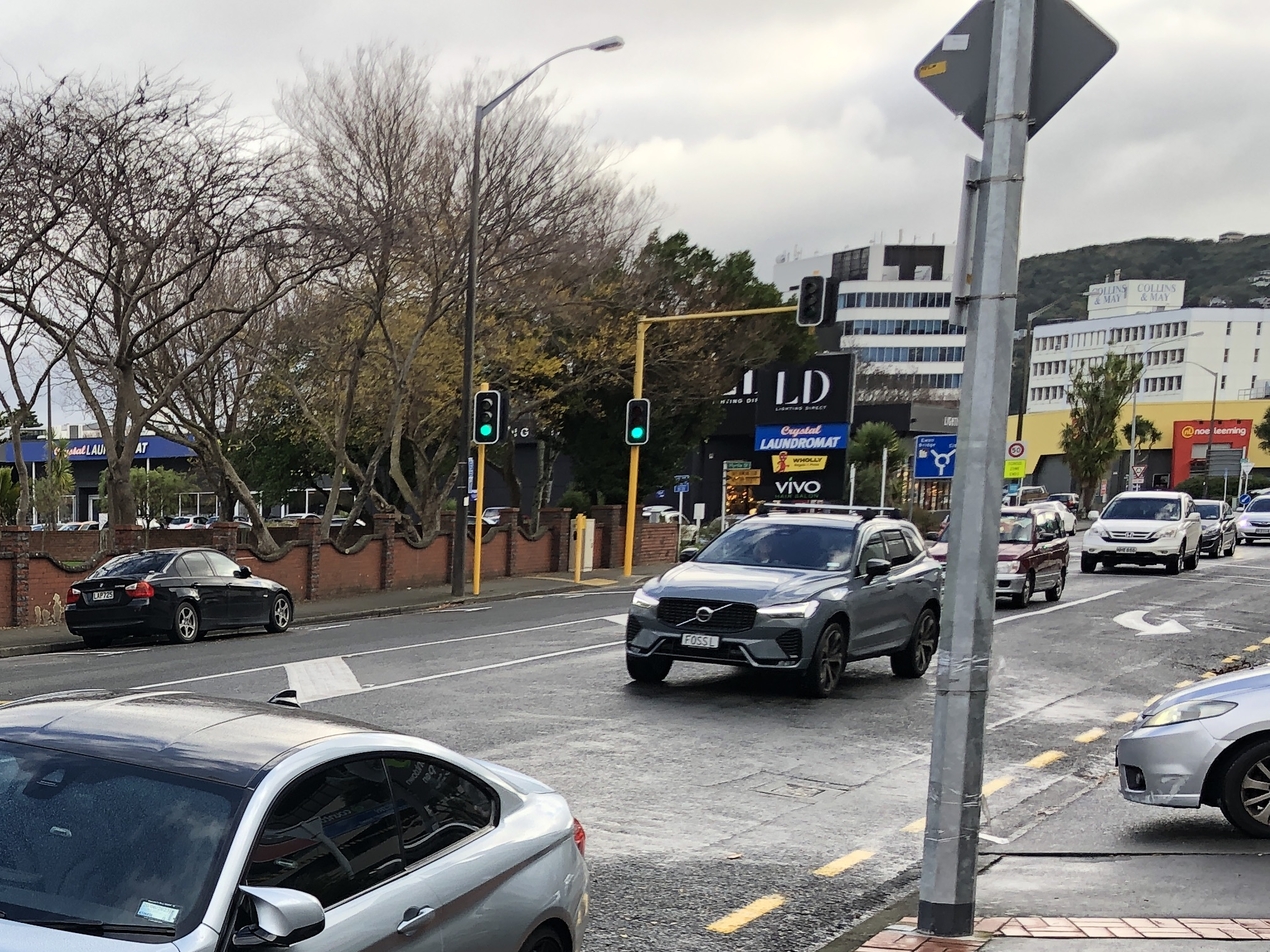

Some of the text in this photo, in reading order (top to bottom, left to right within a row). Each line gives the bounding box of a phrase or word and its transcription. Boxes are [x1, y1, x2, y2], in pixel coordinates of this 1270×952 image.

[1137, 283, 1176, 293] COLLINS
[1104, 293, 1121, 304] MAY
[1141, 293, 1170, 301] & MAY
[780, 425, 822, 438] Crystal
[760, 436, 841, 450] LAUNDROMAT
